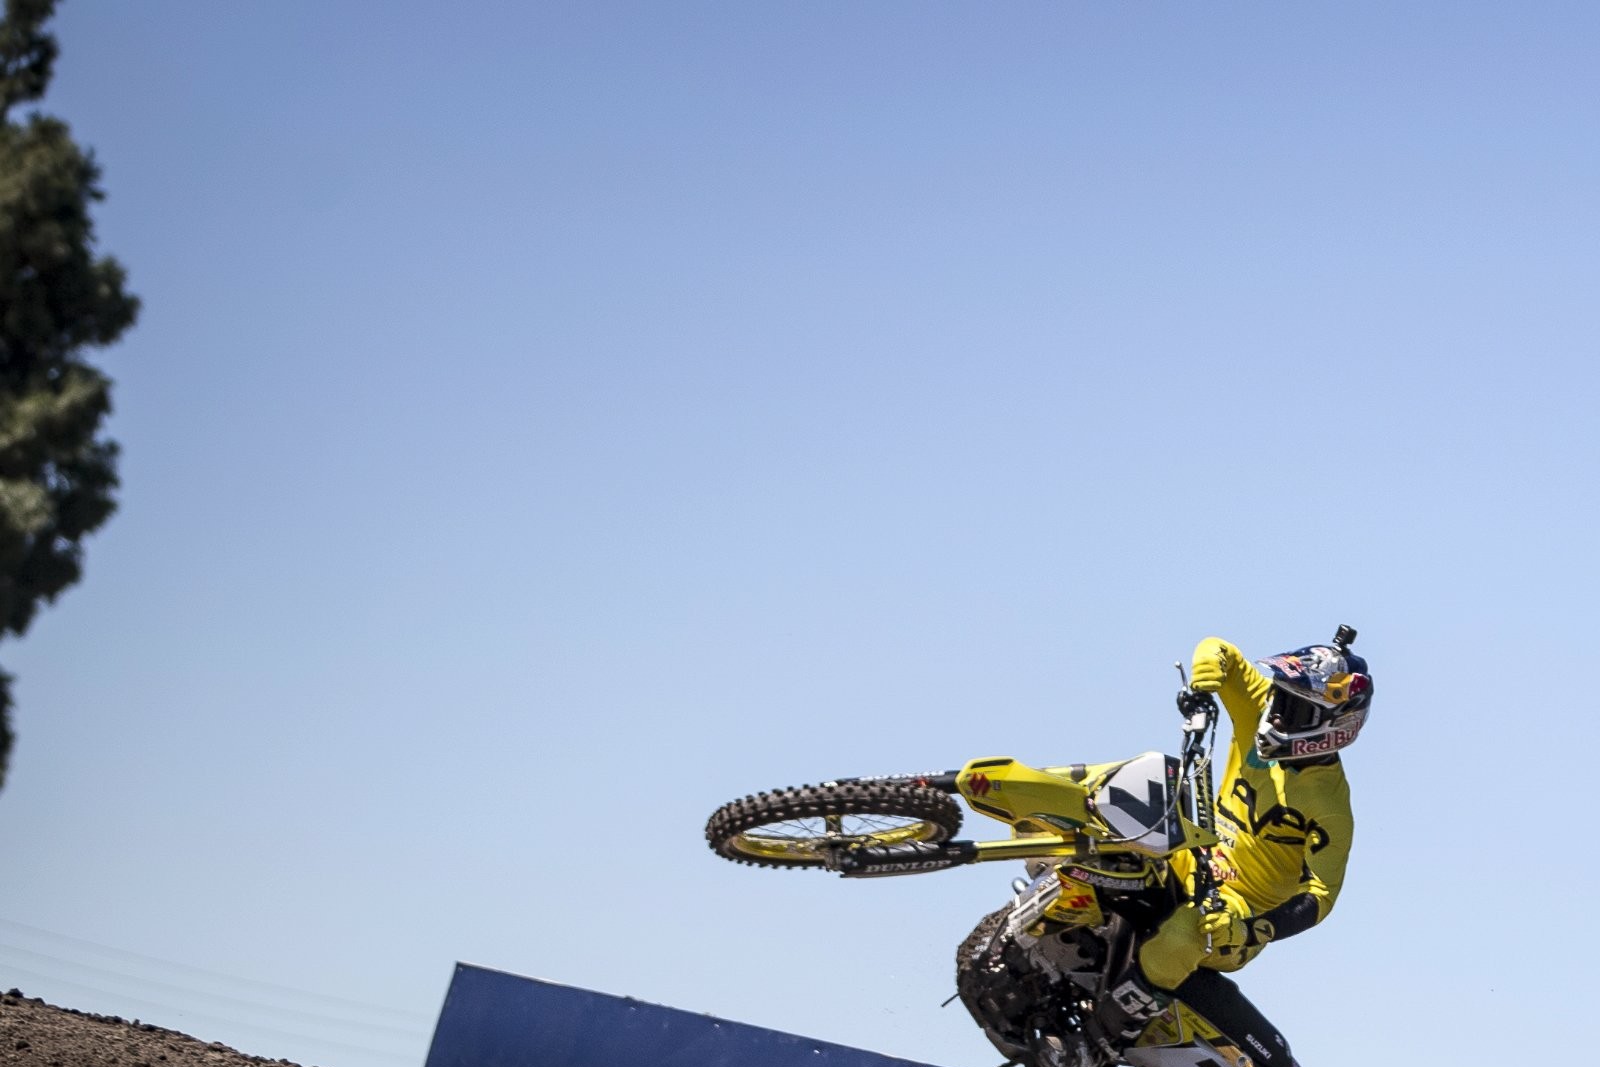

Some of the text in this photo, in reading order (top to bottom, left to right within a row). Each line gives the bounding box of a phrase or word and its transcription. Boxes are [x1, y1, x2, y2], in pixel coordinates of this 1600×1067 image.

[1292, 729, 1334, 756] Red
[865, 859, 952, 874] DUNLOP
[1245, 1033, 1273, 1060] SUZUKI
